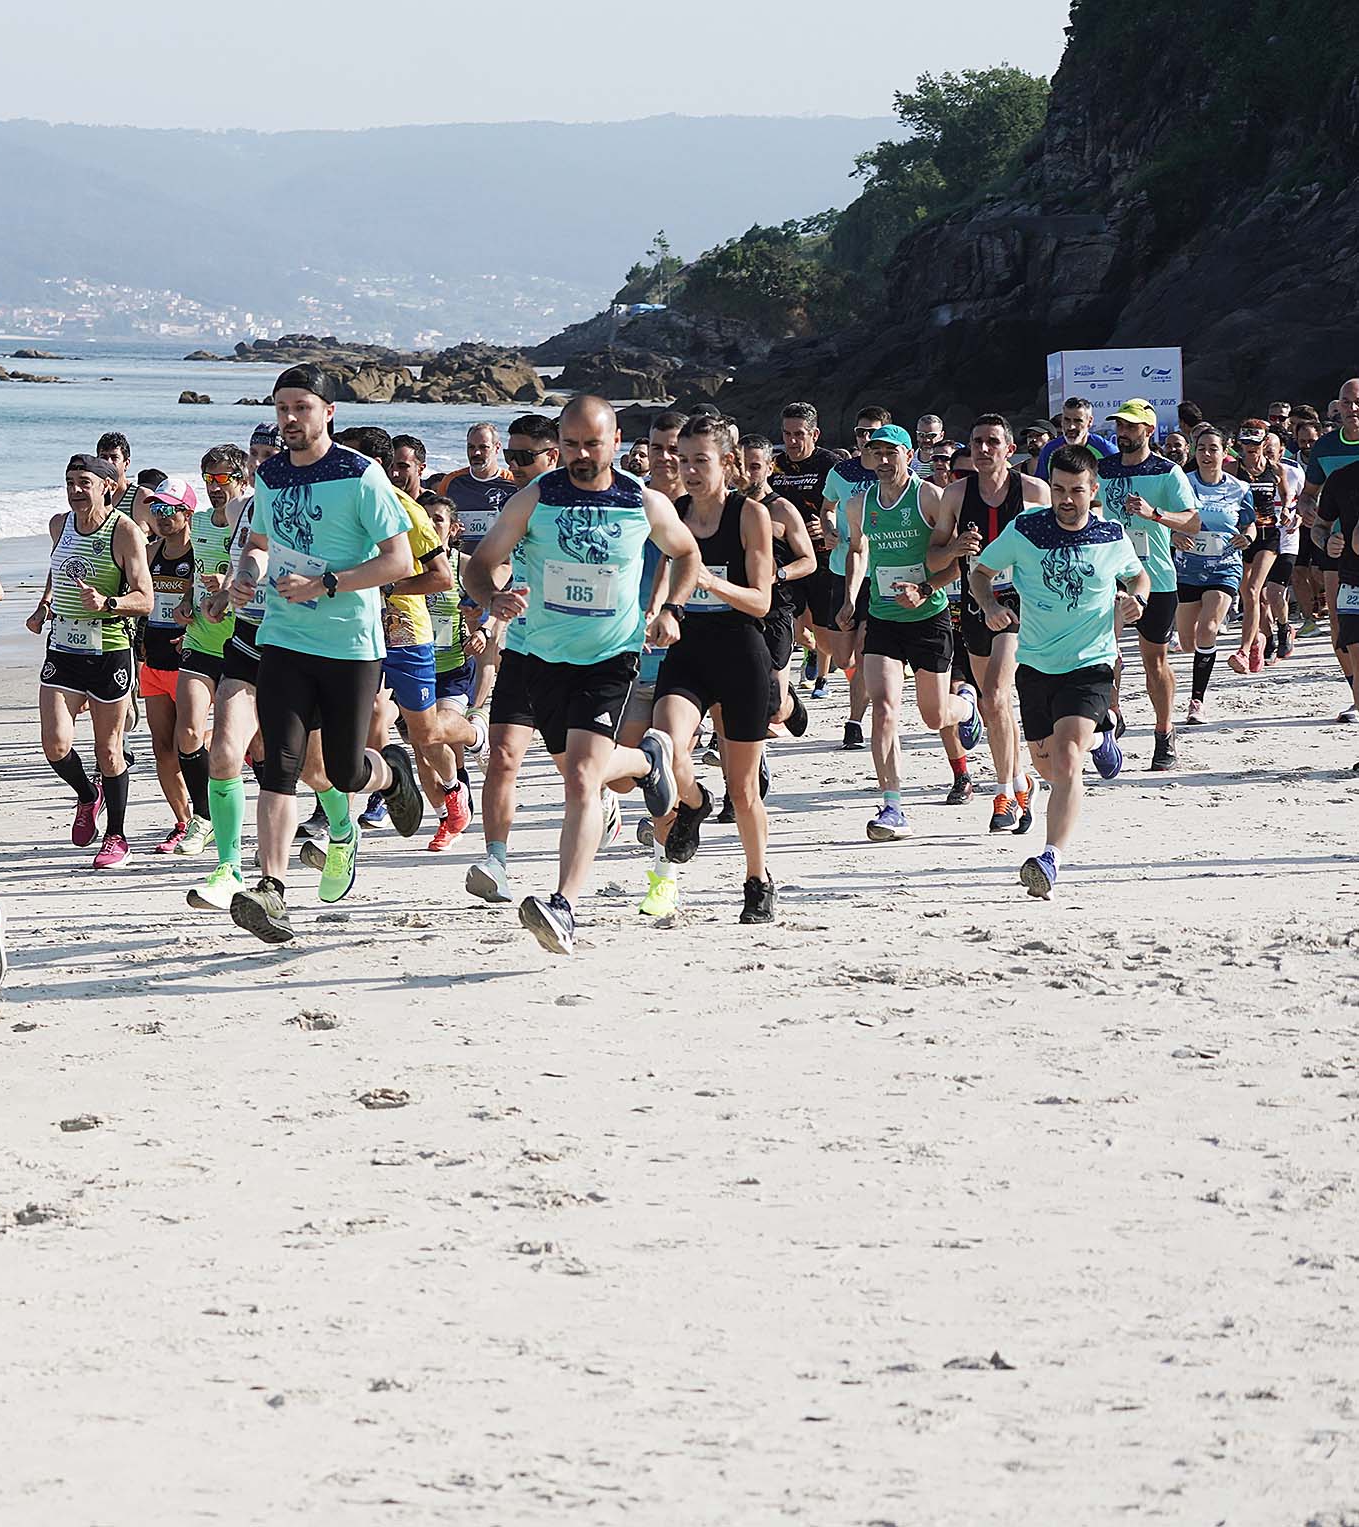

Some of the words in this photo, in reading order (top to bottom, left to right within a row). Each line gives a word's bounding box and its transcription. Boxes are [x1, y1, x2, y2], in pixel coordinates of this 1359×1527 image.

[1160, 398, 1177, 406] 2025
[469, 522, 488, 532] 304
[880, 528, 921, 540] MIGUEL
[877, 539, 909, 550] MARÍN
[1195, 542, 1207, 552] 77
[564, 585, 594, 603] 185
[66, 632, 87, 646] 262
